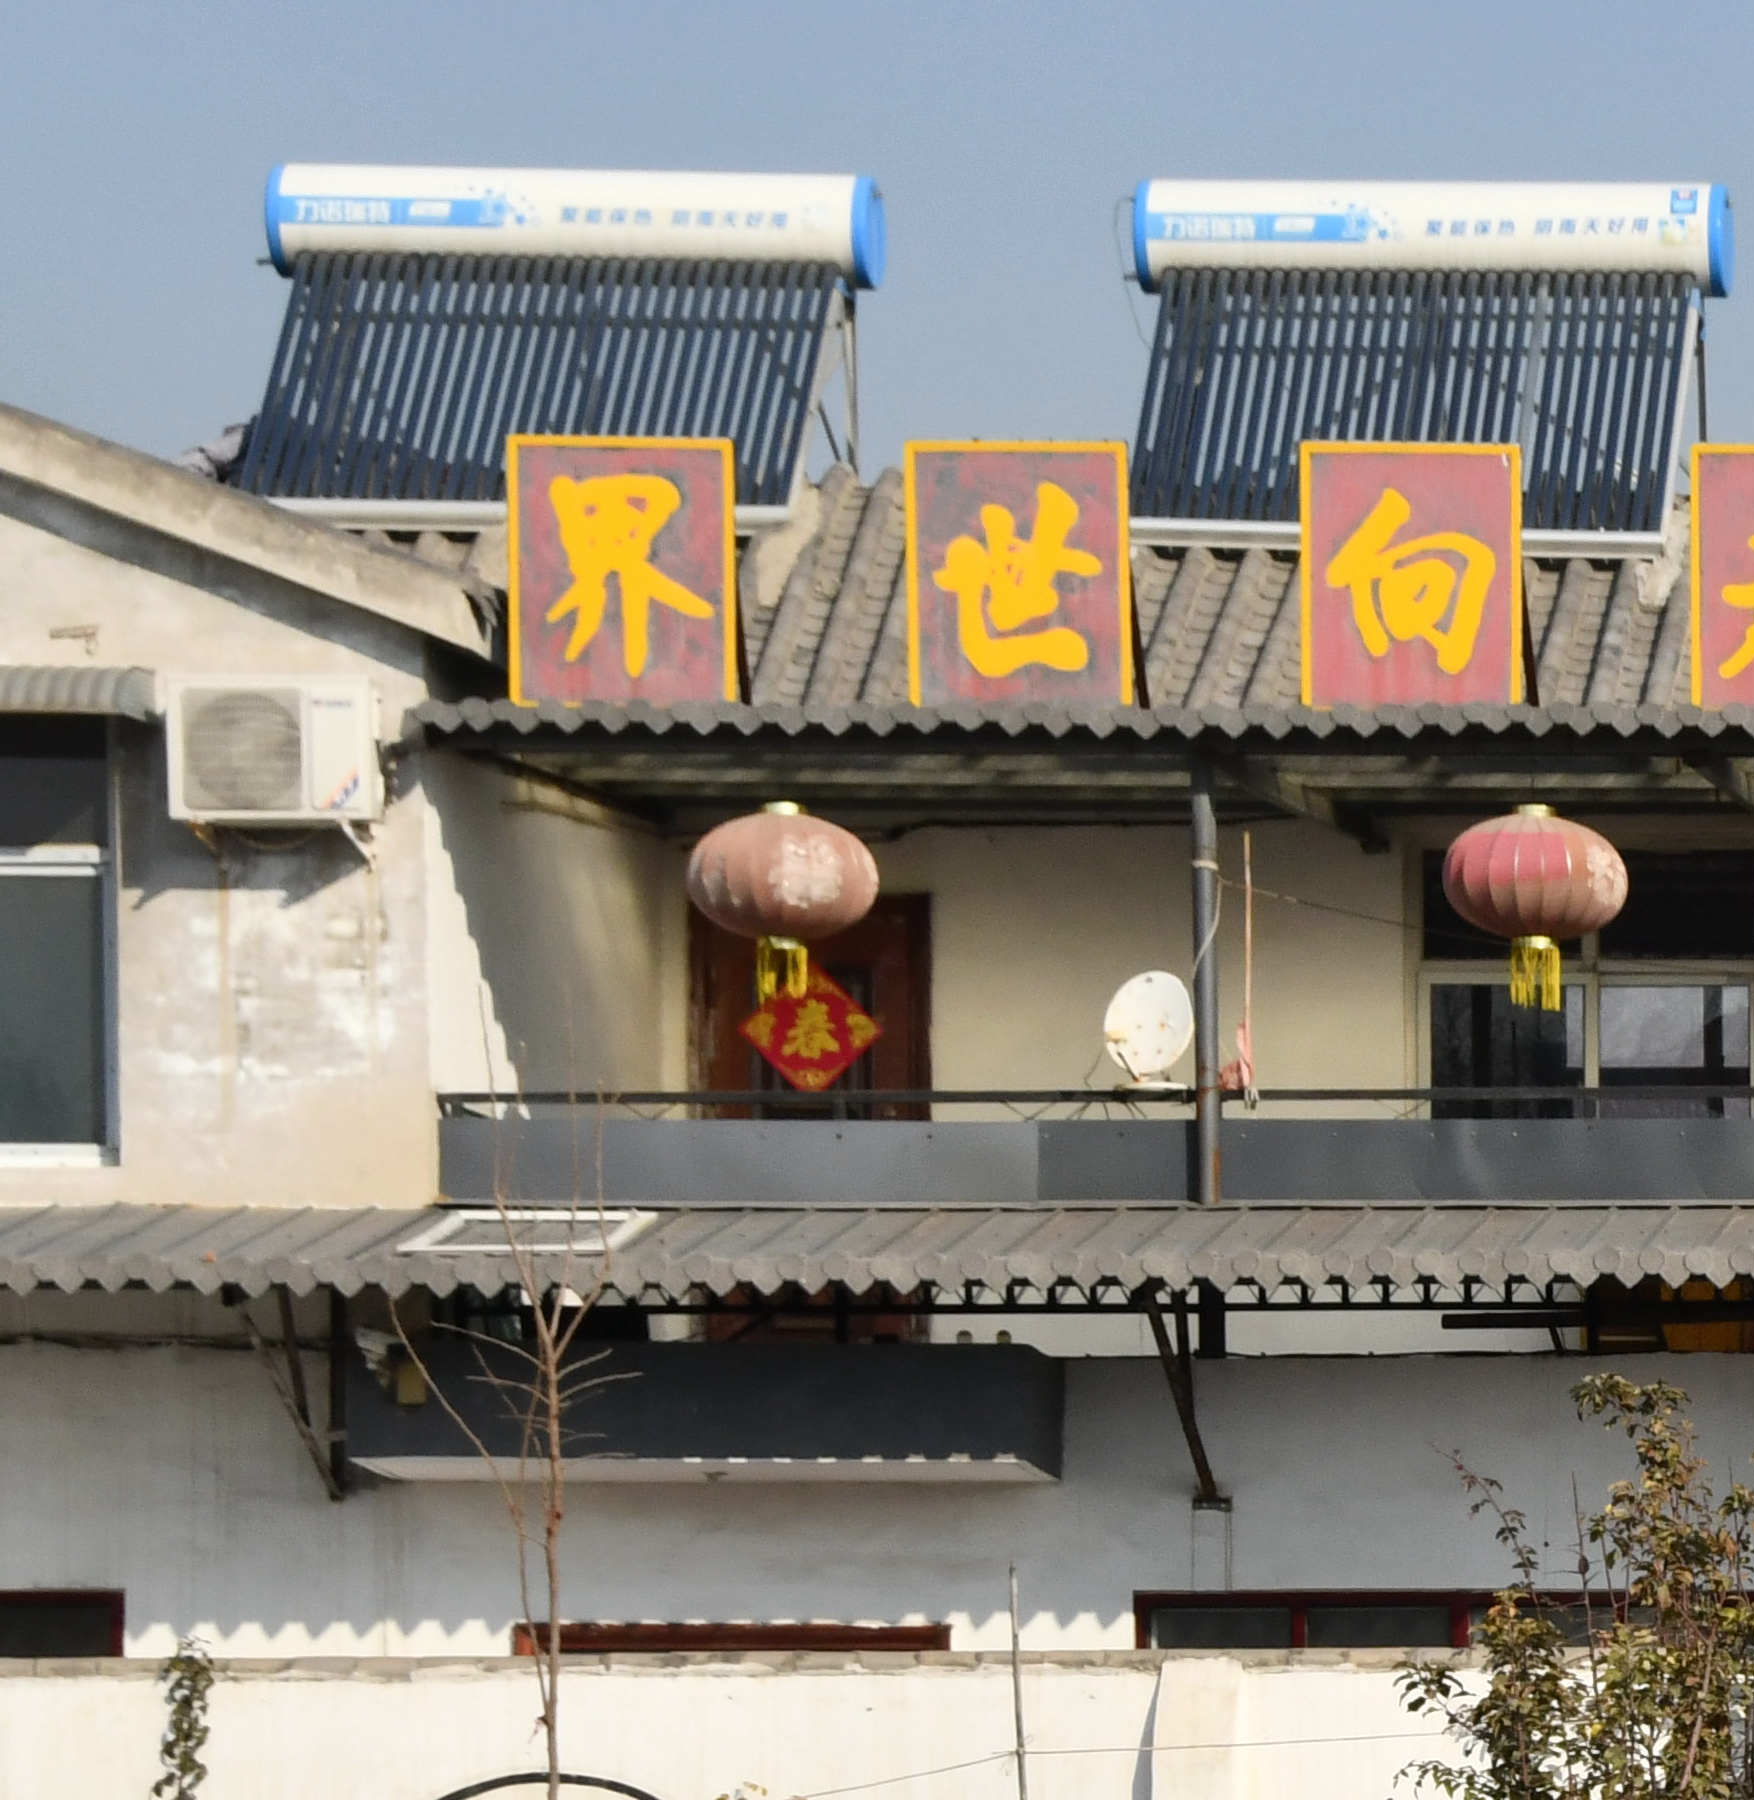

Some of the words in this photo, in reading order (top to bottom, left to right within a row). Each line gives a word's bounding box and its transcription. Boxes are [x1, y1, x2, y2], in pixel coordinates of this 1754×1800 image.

[546, 473, 713, 678] 界
[934, 482, 1103, 677] 世
[1326, 487, 1496, 674] 向
[782, 999, 840, 1060] 春
